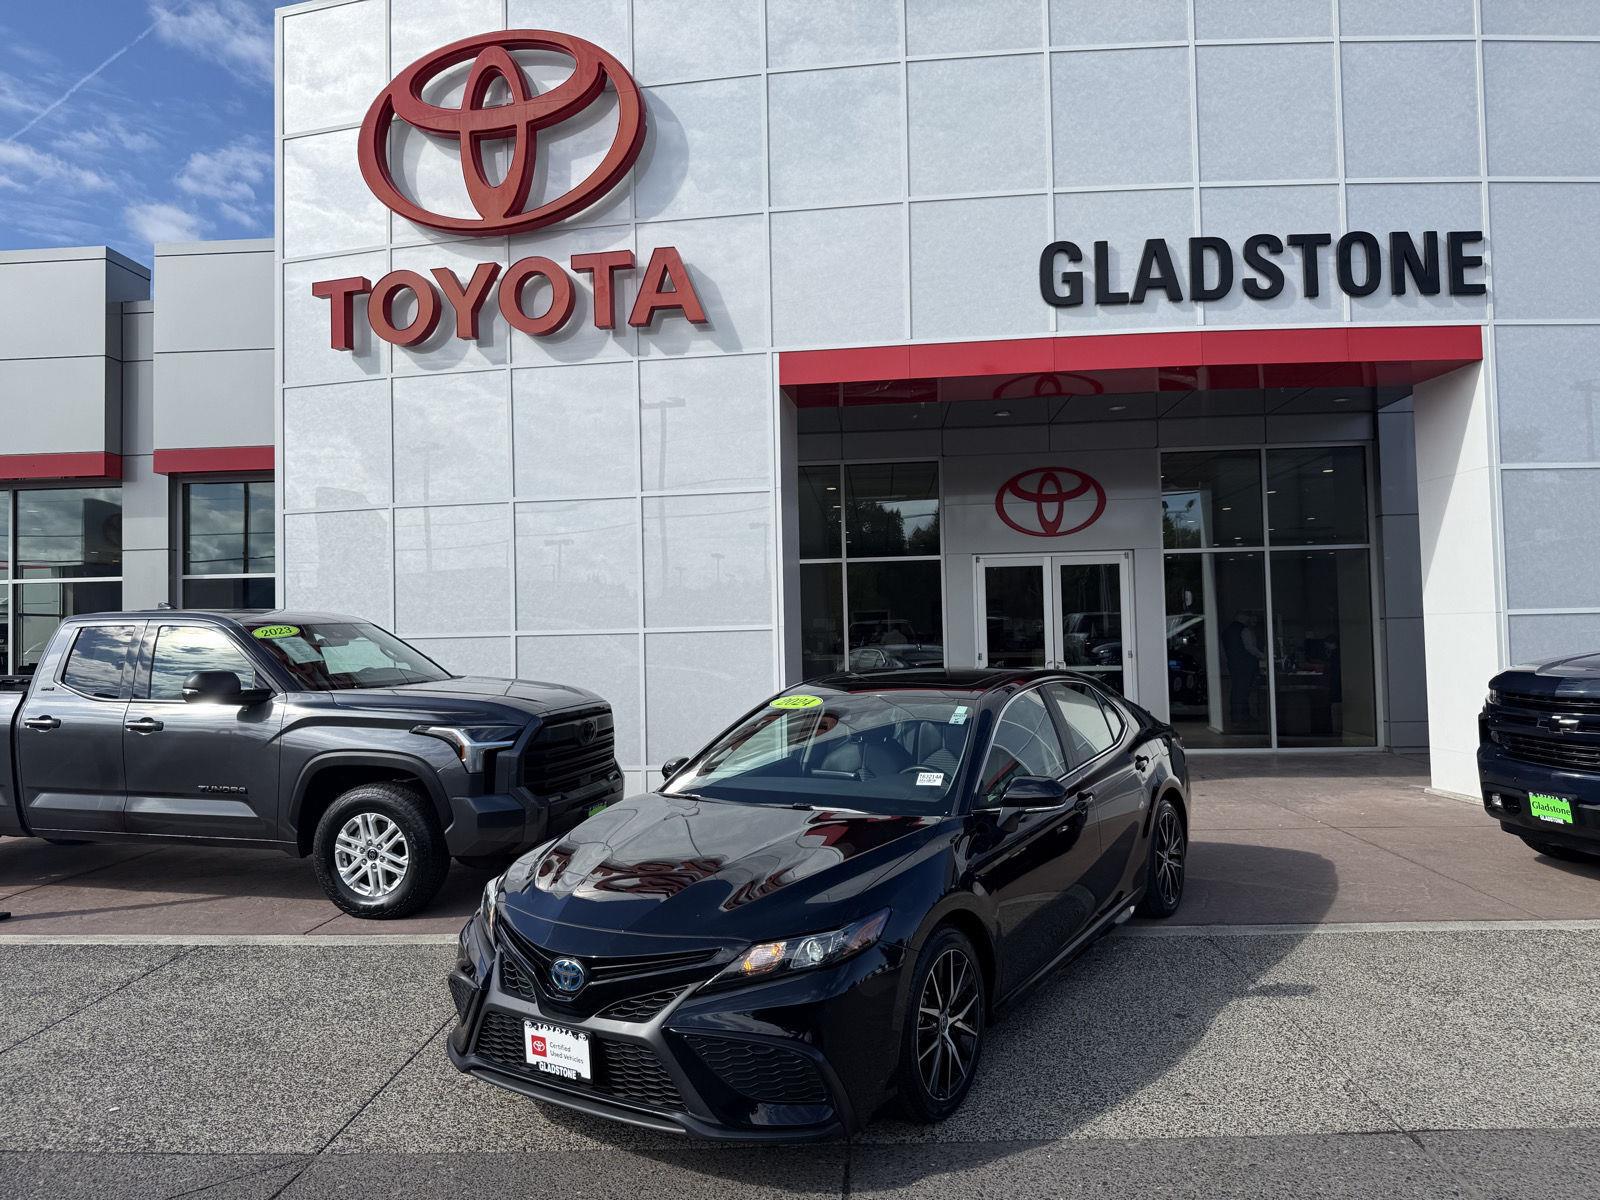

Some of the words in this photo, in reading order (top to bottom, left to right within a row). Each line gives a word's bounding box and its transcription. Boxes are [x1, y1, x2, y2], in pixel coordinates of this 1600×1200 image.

[1039, 230, 1487, 307] GLADSTONE
[311, 246, 708, 352] TOYOTA
[261, 627, 292, 637] 2023
[1531, 800, 1571, 816] Gladstone
[537, 1023, 573, 1037] TOYOTA
[549, 1041, 571, 1053] Certified
[549, 1050, 563, 1059] Used
[563, 1053, 584, 1065] Vehicles
[538, 1061, 577, 1080] GLADSTONE
